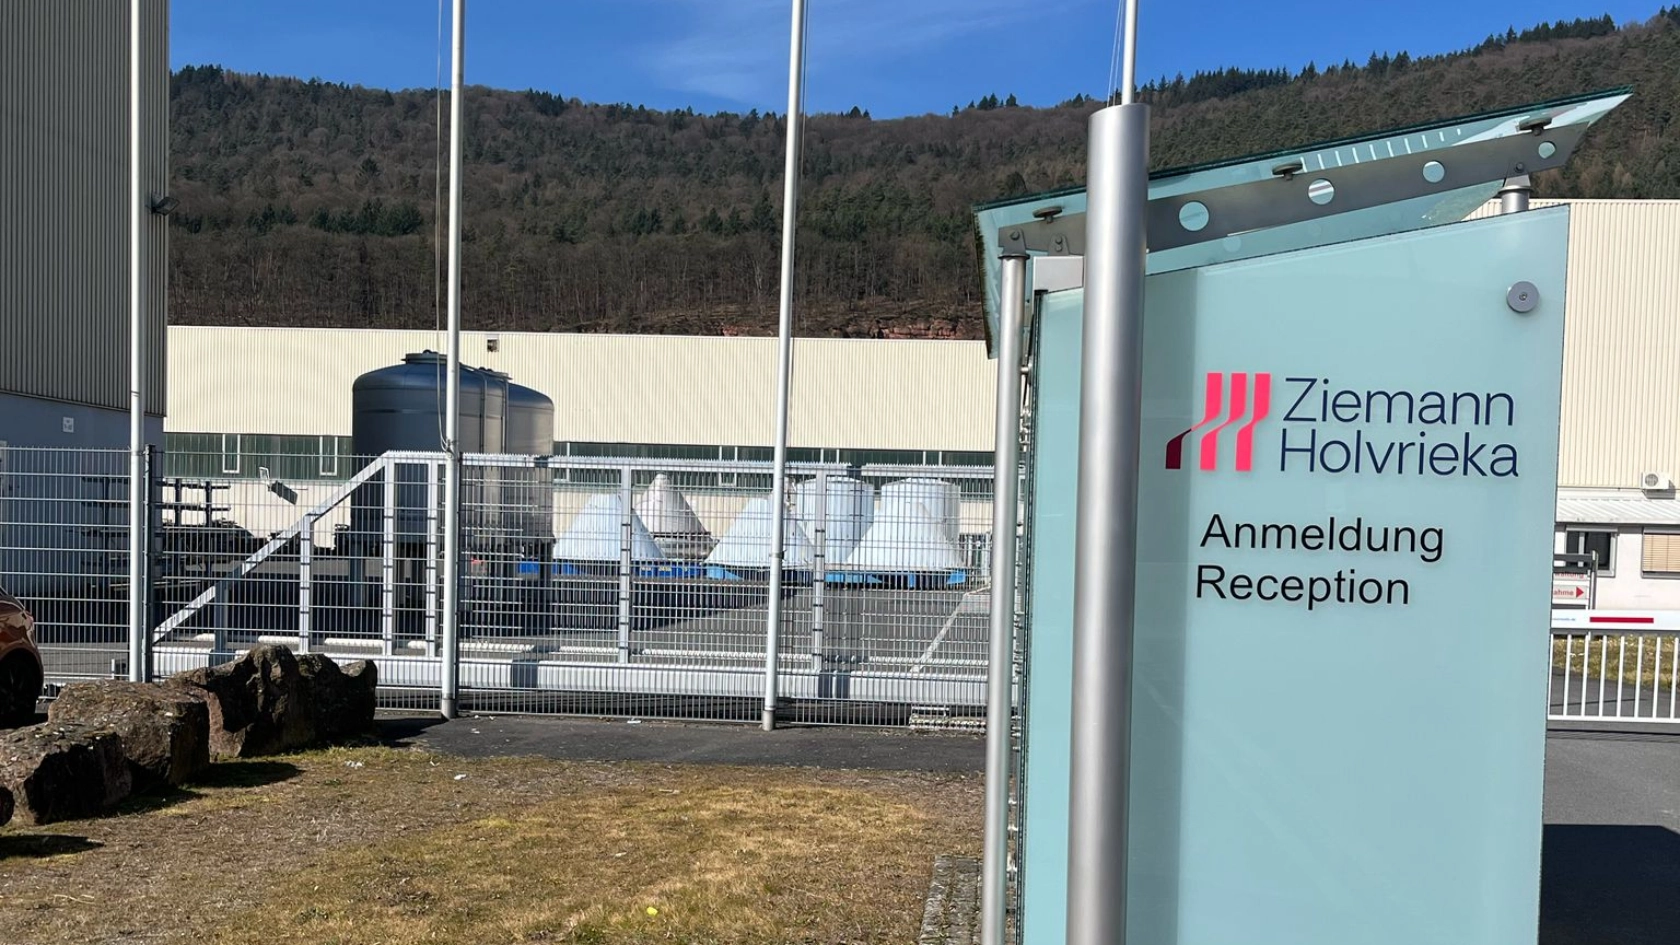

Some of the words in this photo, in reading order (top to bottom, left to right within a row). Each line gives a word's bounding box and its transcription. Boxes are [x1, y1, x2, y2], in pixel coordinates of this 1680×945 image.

[1283, 376, 1514, 426] Ziemann
[1280, 428, 1519, 477] Holvrieka
[1200, 514, 1445, 563] Anmeldung
[1197, 565, 1409, 612] Reception
